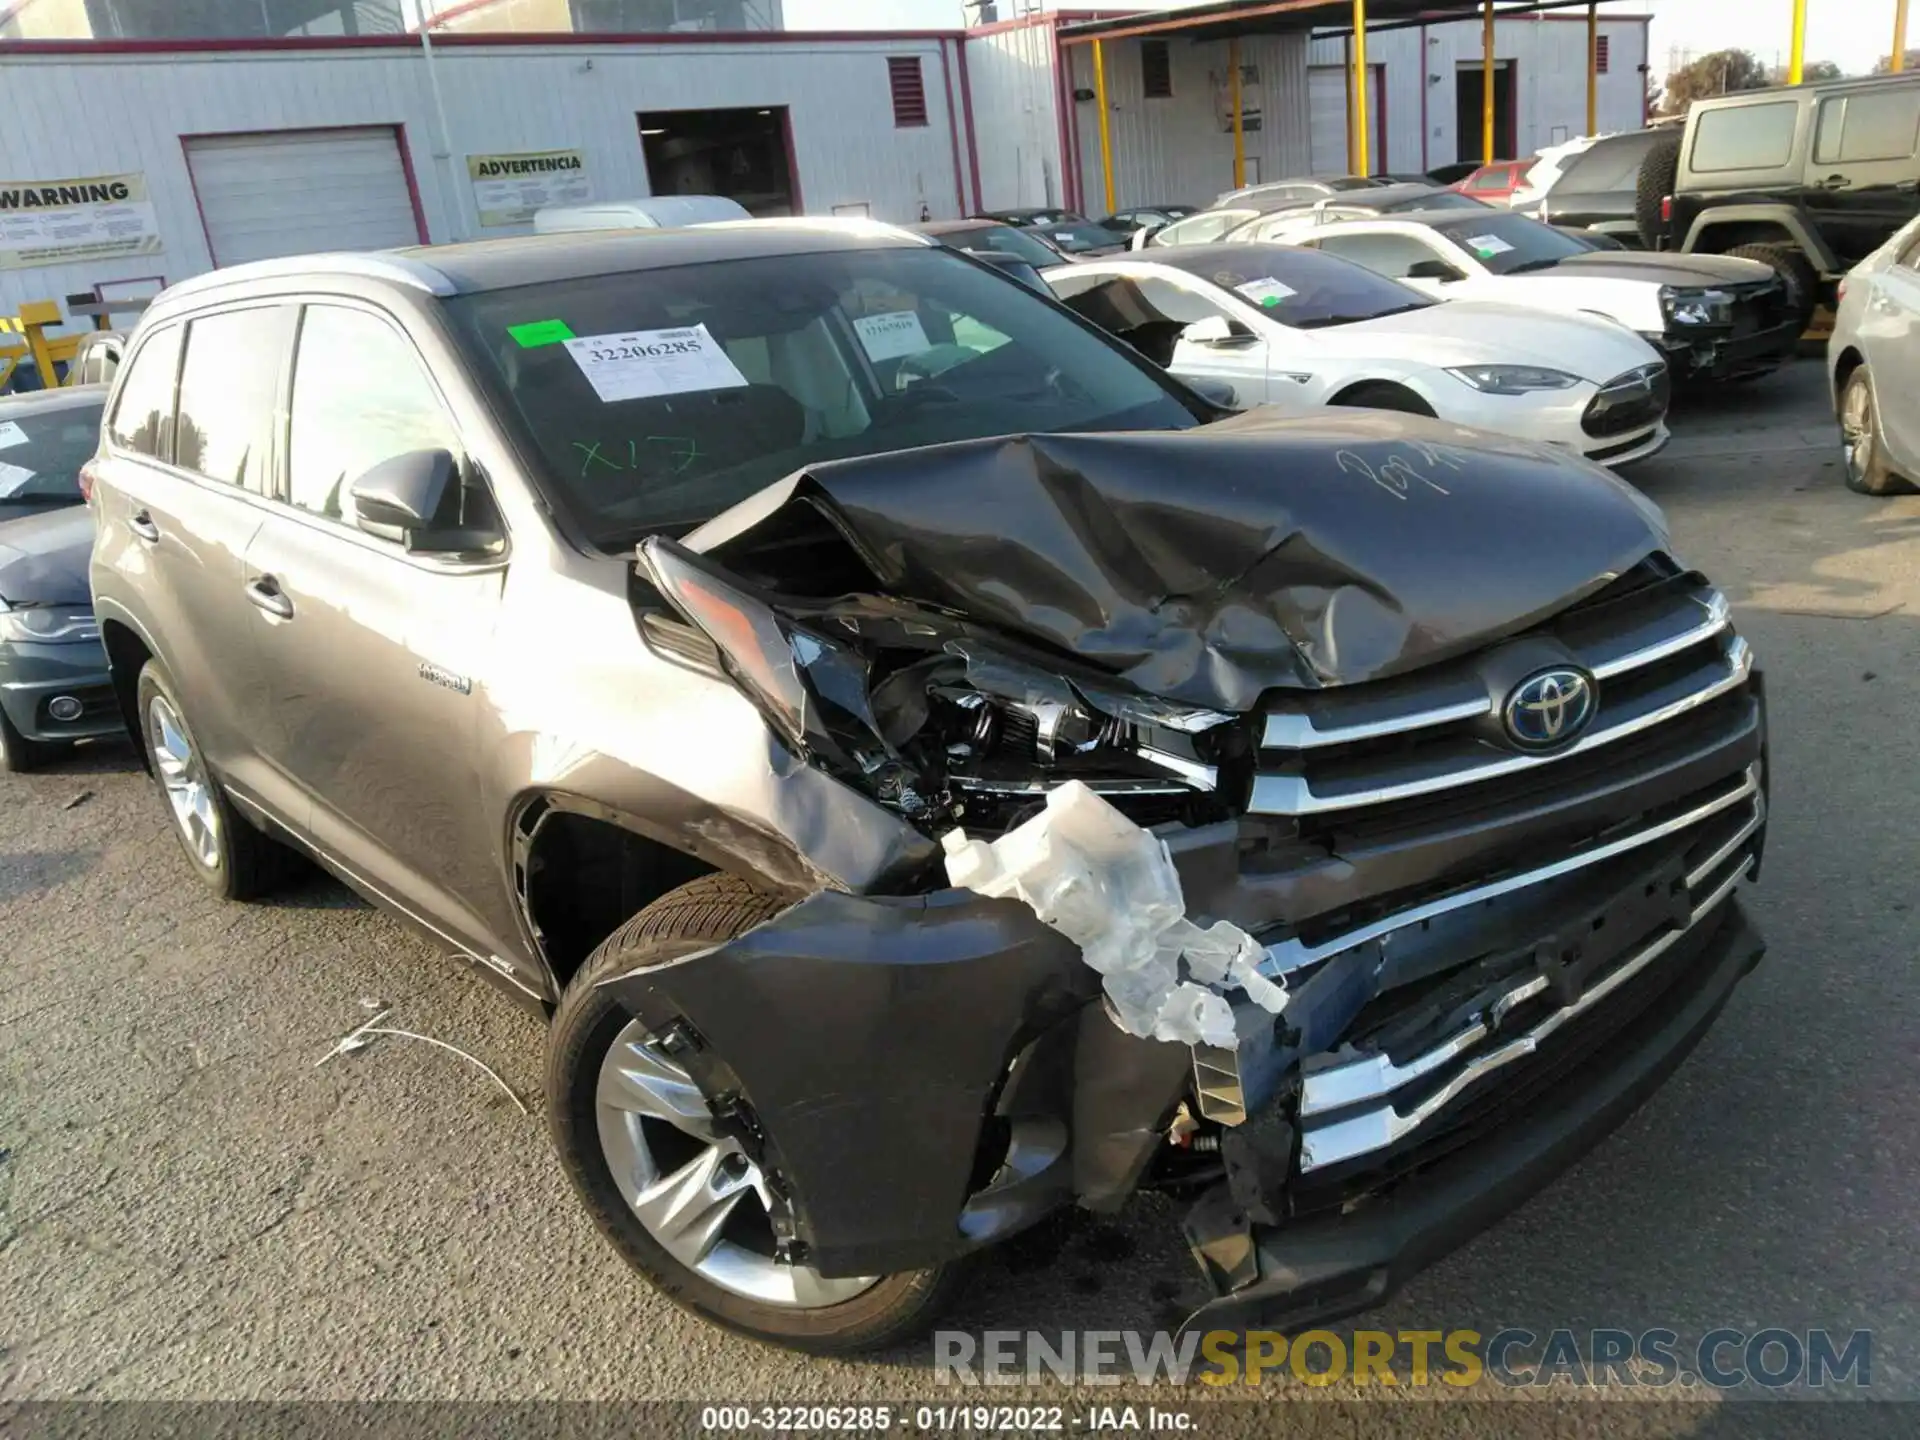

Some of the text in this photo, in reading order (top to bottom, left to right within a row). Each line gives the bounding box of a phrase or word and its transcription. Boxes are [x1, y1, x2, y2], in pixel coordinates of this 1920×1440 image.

[479, 156, 581, 177] ADVERTENCIA
[0, 182, 129, 209] WARNING
[588, 340, 702, 363] 32206285
